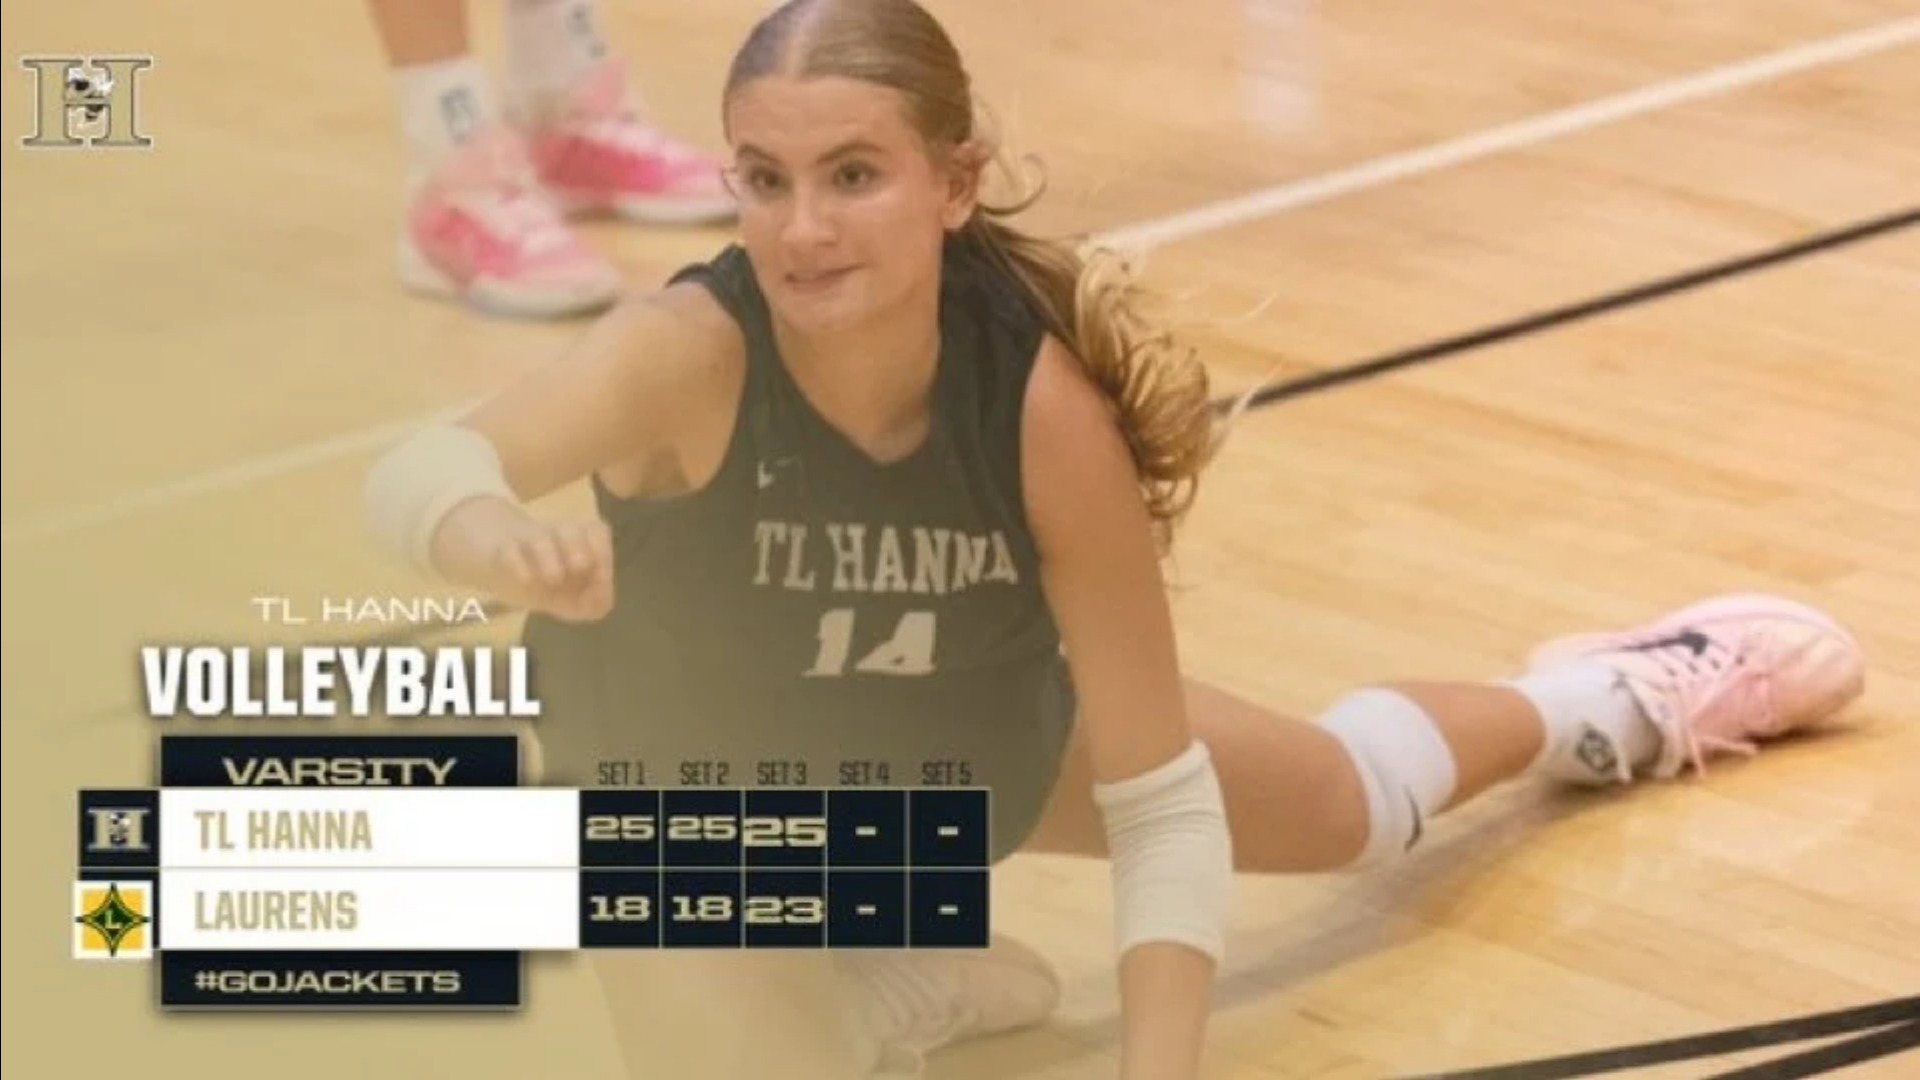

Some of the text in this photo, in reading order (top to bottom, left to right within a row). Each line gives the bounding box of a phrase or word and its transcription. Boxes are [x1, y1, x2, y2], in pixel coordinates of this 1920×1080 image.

[752, 520, 1019, 595] TL HANNA
[801, 607, 937, 676] 14
